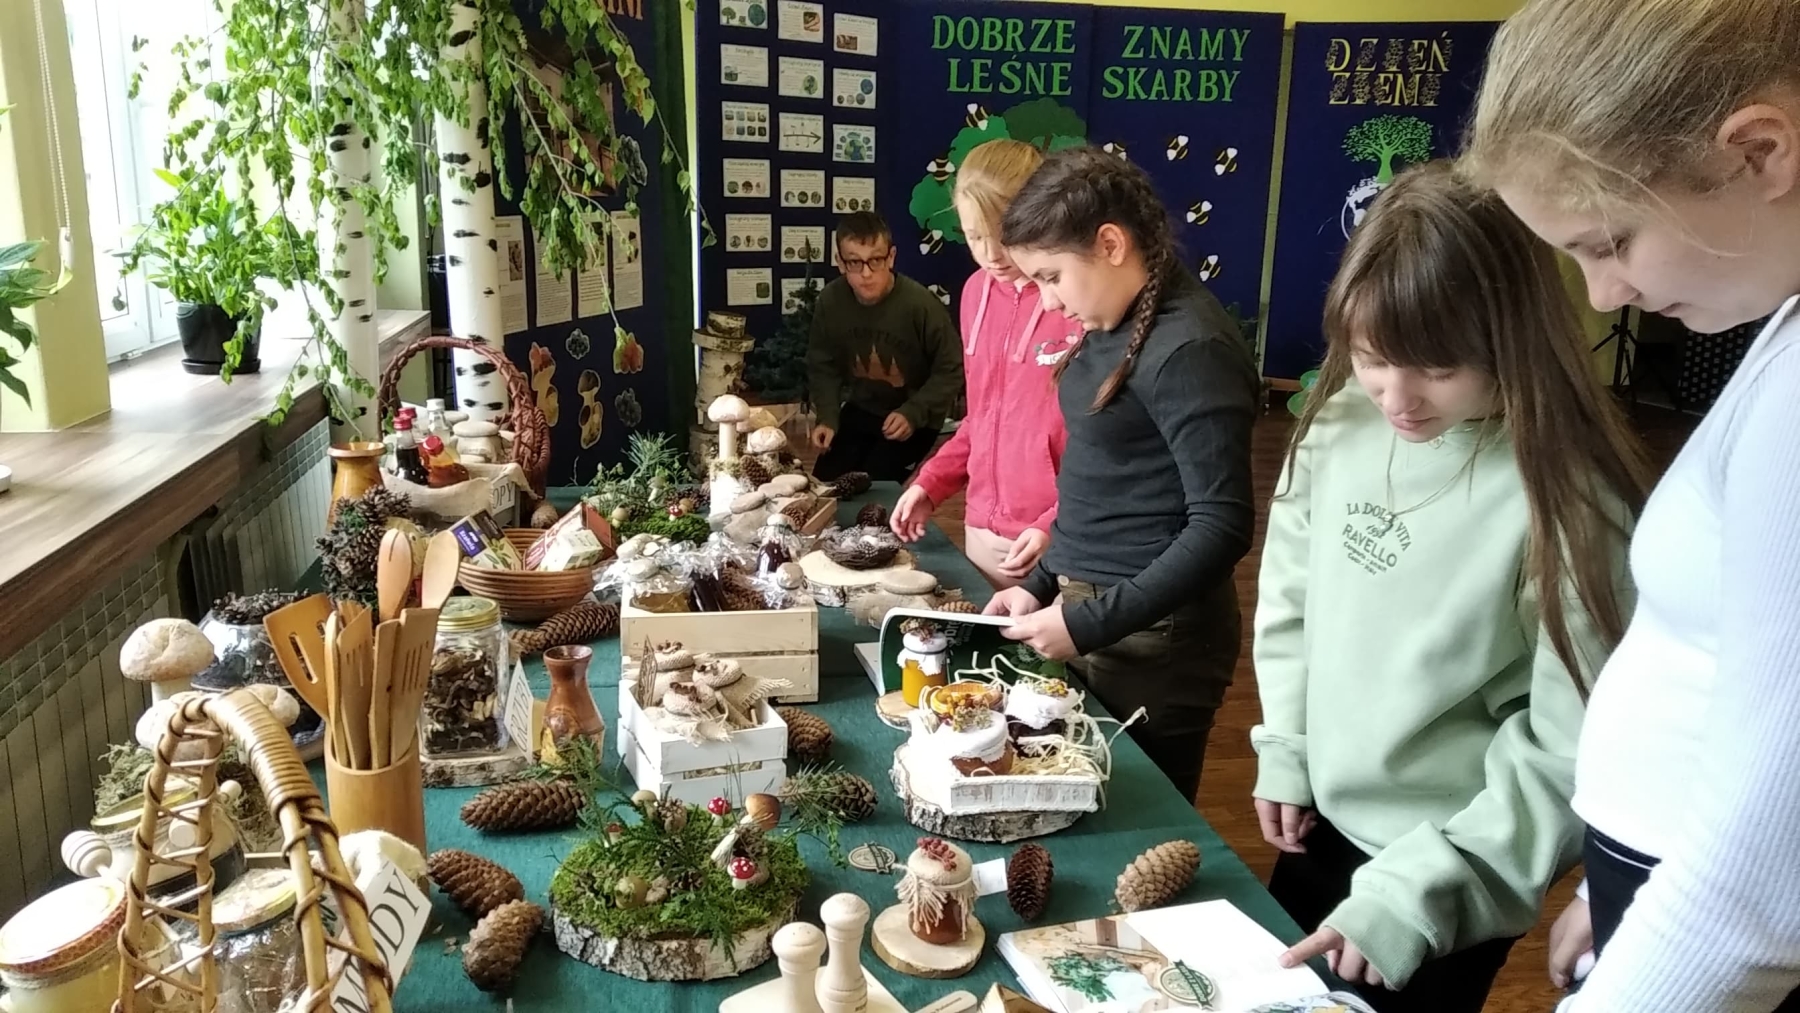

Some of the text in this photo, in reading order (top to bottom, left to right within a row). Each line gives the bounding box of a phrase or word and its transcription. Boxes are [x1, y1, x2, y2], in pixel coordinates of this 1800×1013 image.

[931, 15, 1251, 61] DOBRZE ZNAMY
[1325, 31, 1453, 72] DZIEŃ
[947, 54, 1240, 102] LEŚNE SKARBY
[1329, 72, 1442, 106] ZIEMI
[1342, 523, 1397, 567] RAVELLO
[1346, 502, 1360, 515] LA
[1395, 521, 1411, 552] VITA
